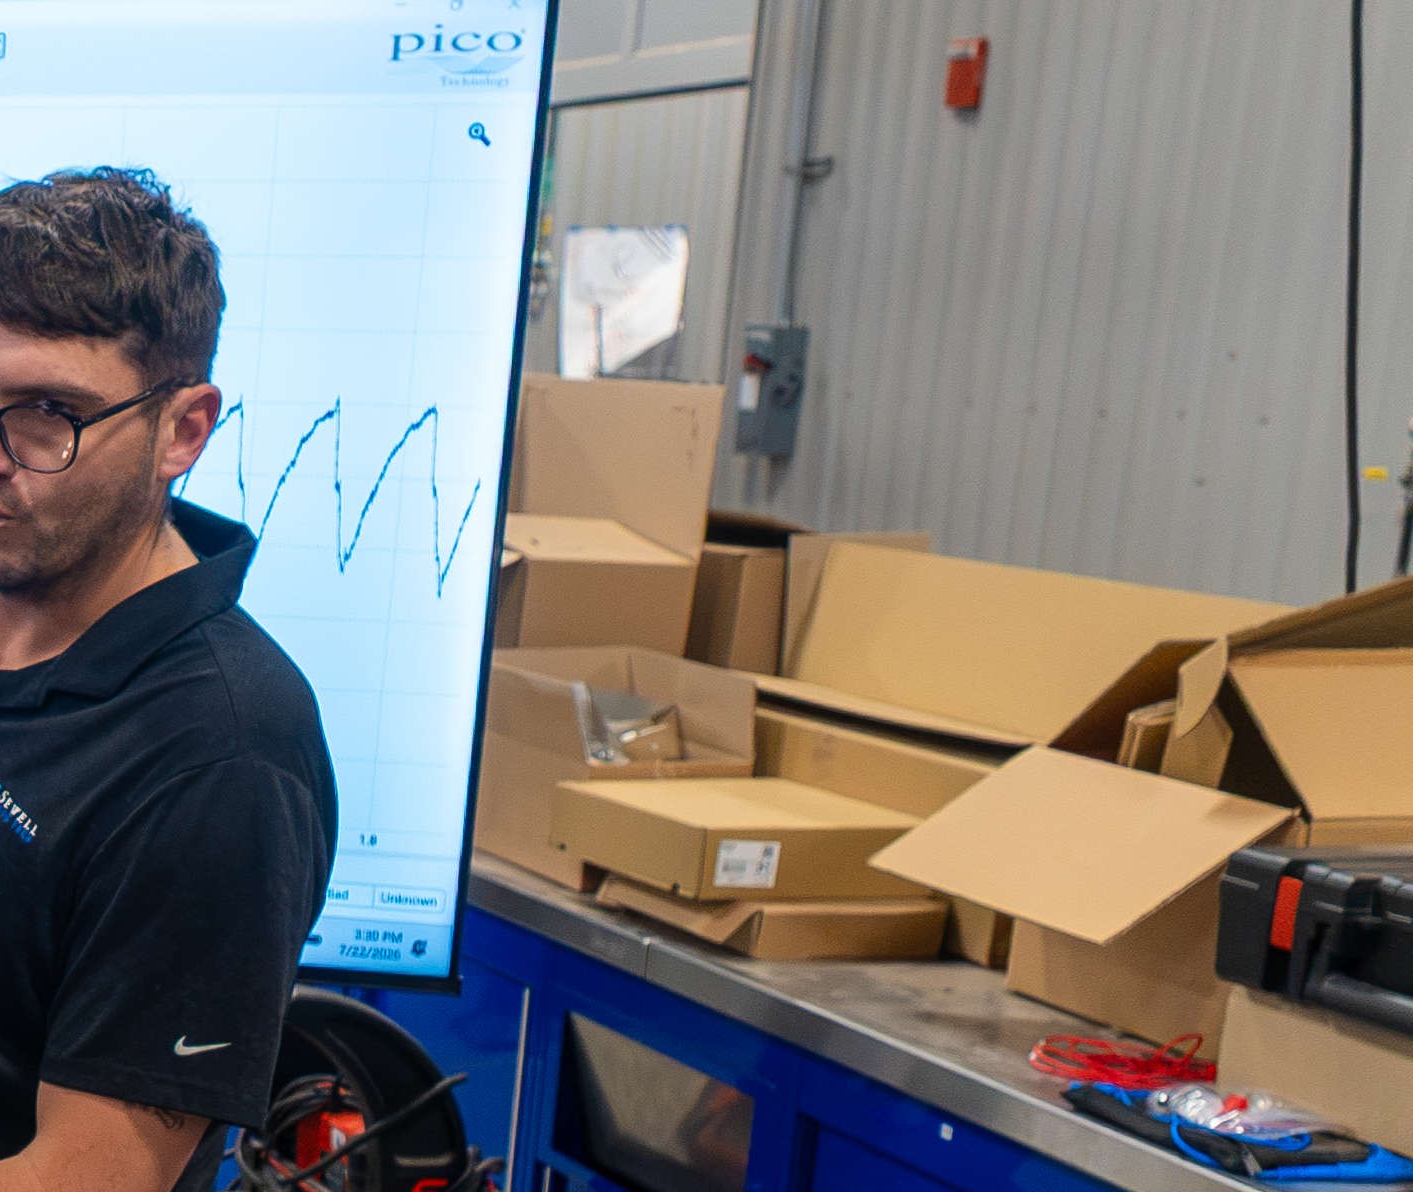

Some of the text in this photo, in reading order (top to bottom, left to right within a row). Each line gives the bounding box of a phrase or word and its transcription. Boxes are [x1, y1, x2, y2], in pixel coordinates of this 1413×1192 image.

[388, 24, 524, 61] pico
[359, 833, 378, 847] 1.8
[380, 890, 438, 908] Unknown
[381, 928, 404, 945] PM
